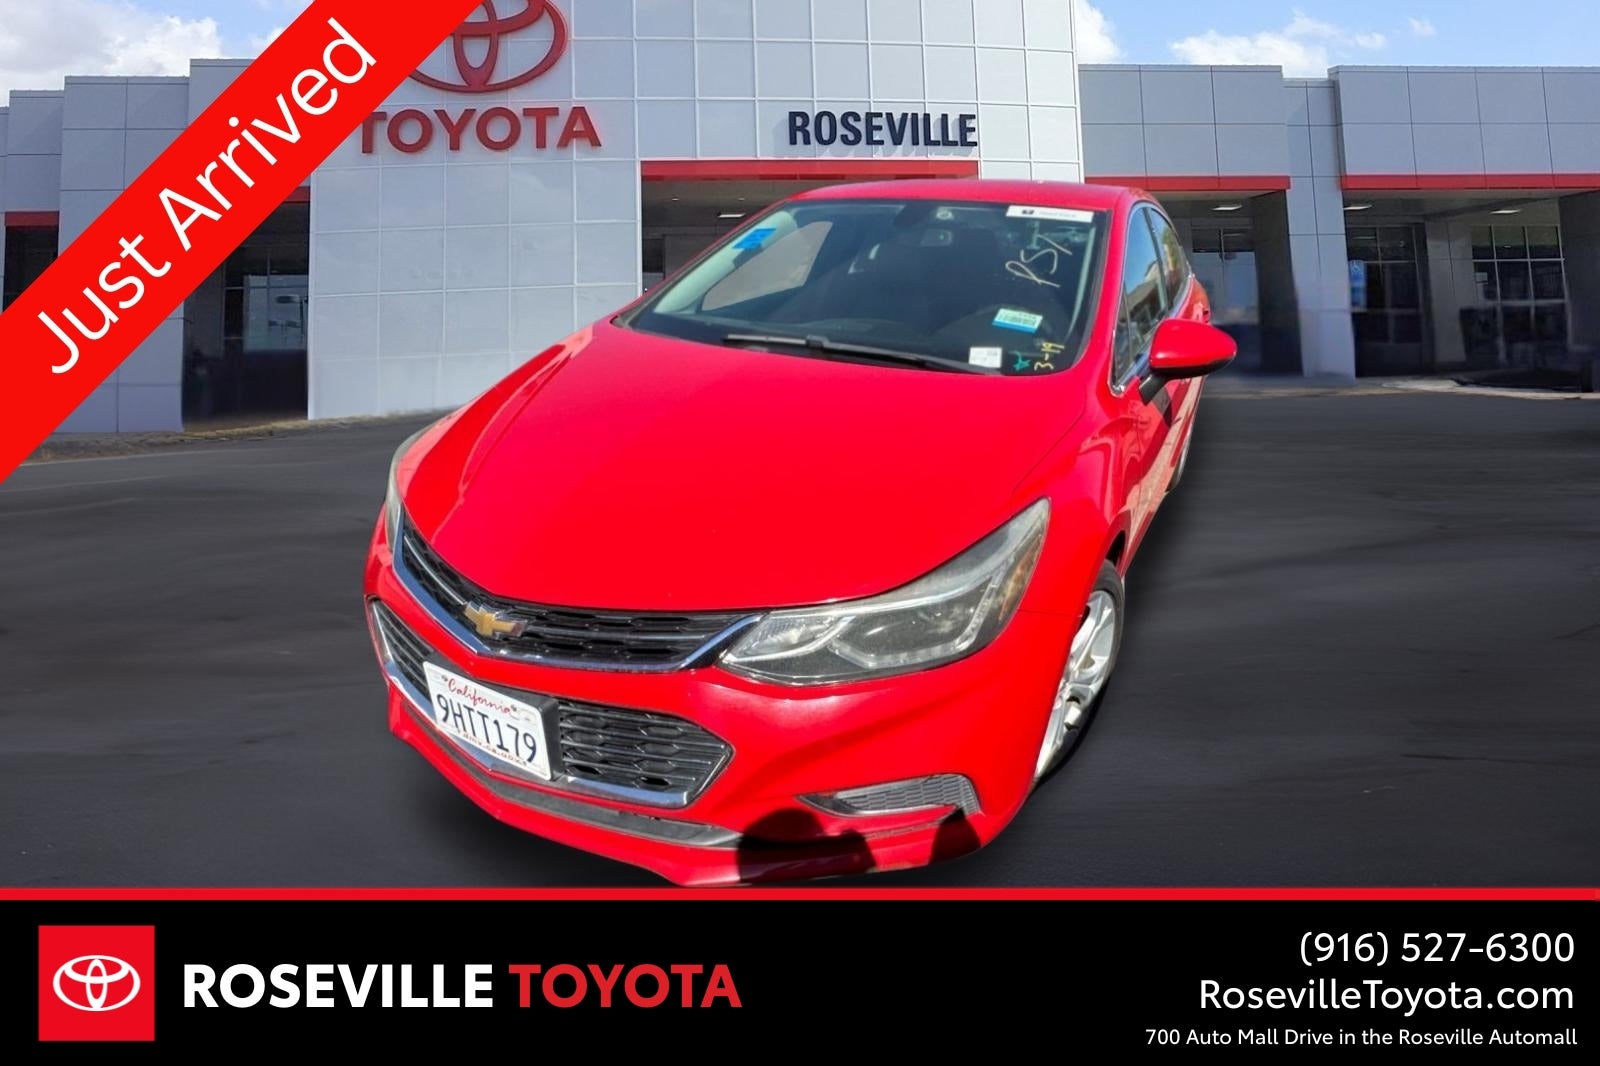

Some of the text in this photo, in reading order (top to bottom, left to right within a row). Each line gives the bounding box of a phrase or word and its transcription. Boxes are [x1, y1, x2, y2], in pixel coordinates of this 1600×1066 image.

[361, 106, 602, 154] TOYOTA
[788, 111, 978, 147] ROSEVILLE
[447, 678, 513, 715] California
[436, 693, 537, 763] 9HTT179
